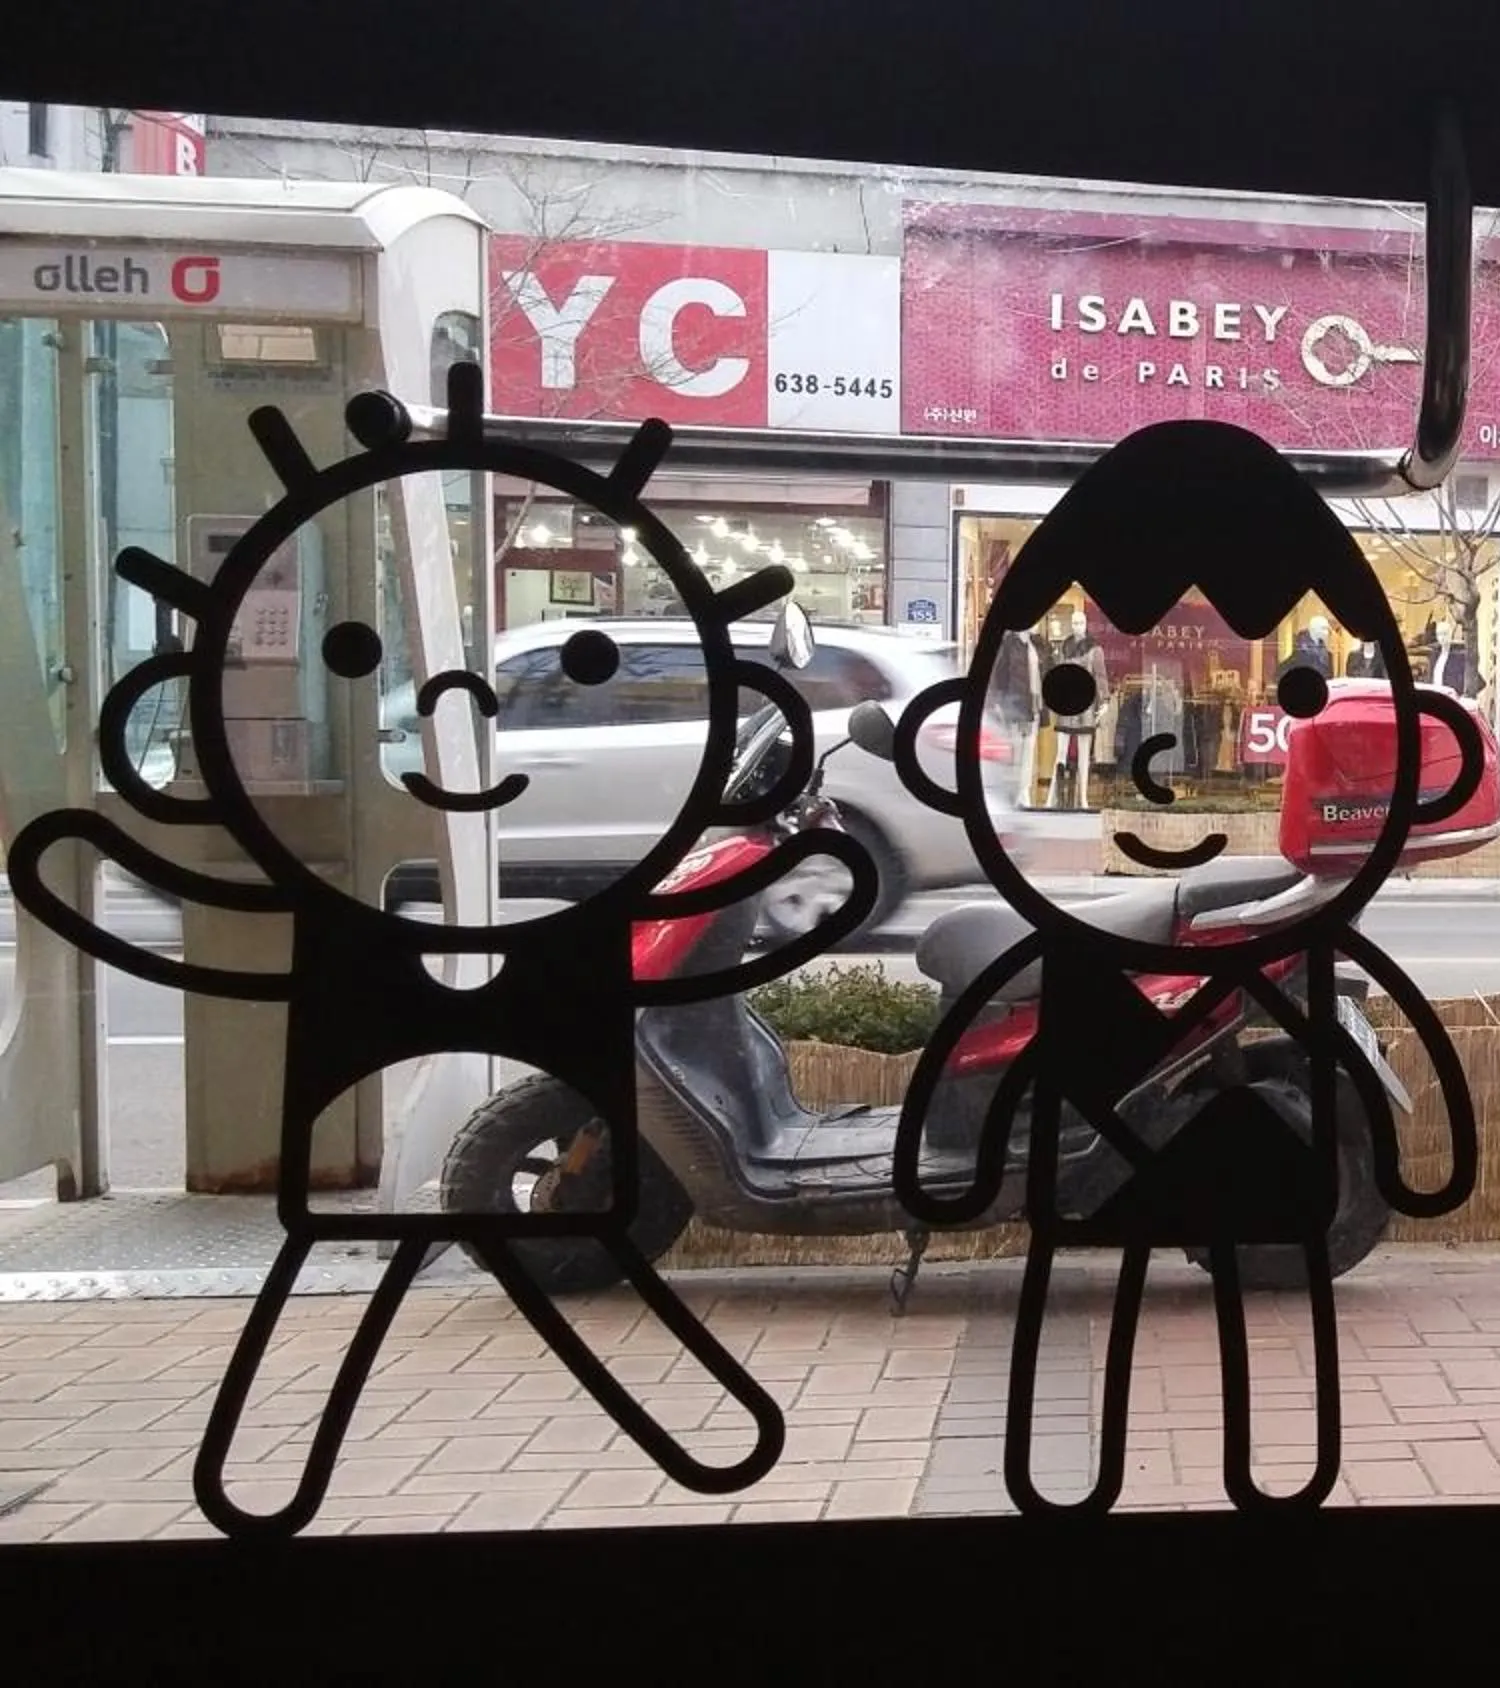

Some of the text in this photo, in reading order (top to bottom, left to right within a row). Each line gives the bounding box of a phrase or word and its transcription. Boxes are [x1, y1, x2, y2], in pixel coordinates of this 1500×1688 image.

[34, 255, 149, 294] olleh
[1050, 293, 1289, 342] ISABEY
[775, 373, 893, 399] 638-5445
[1051, 358, 1281, 390] de PARIS
